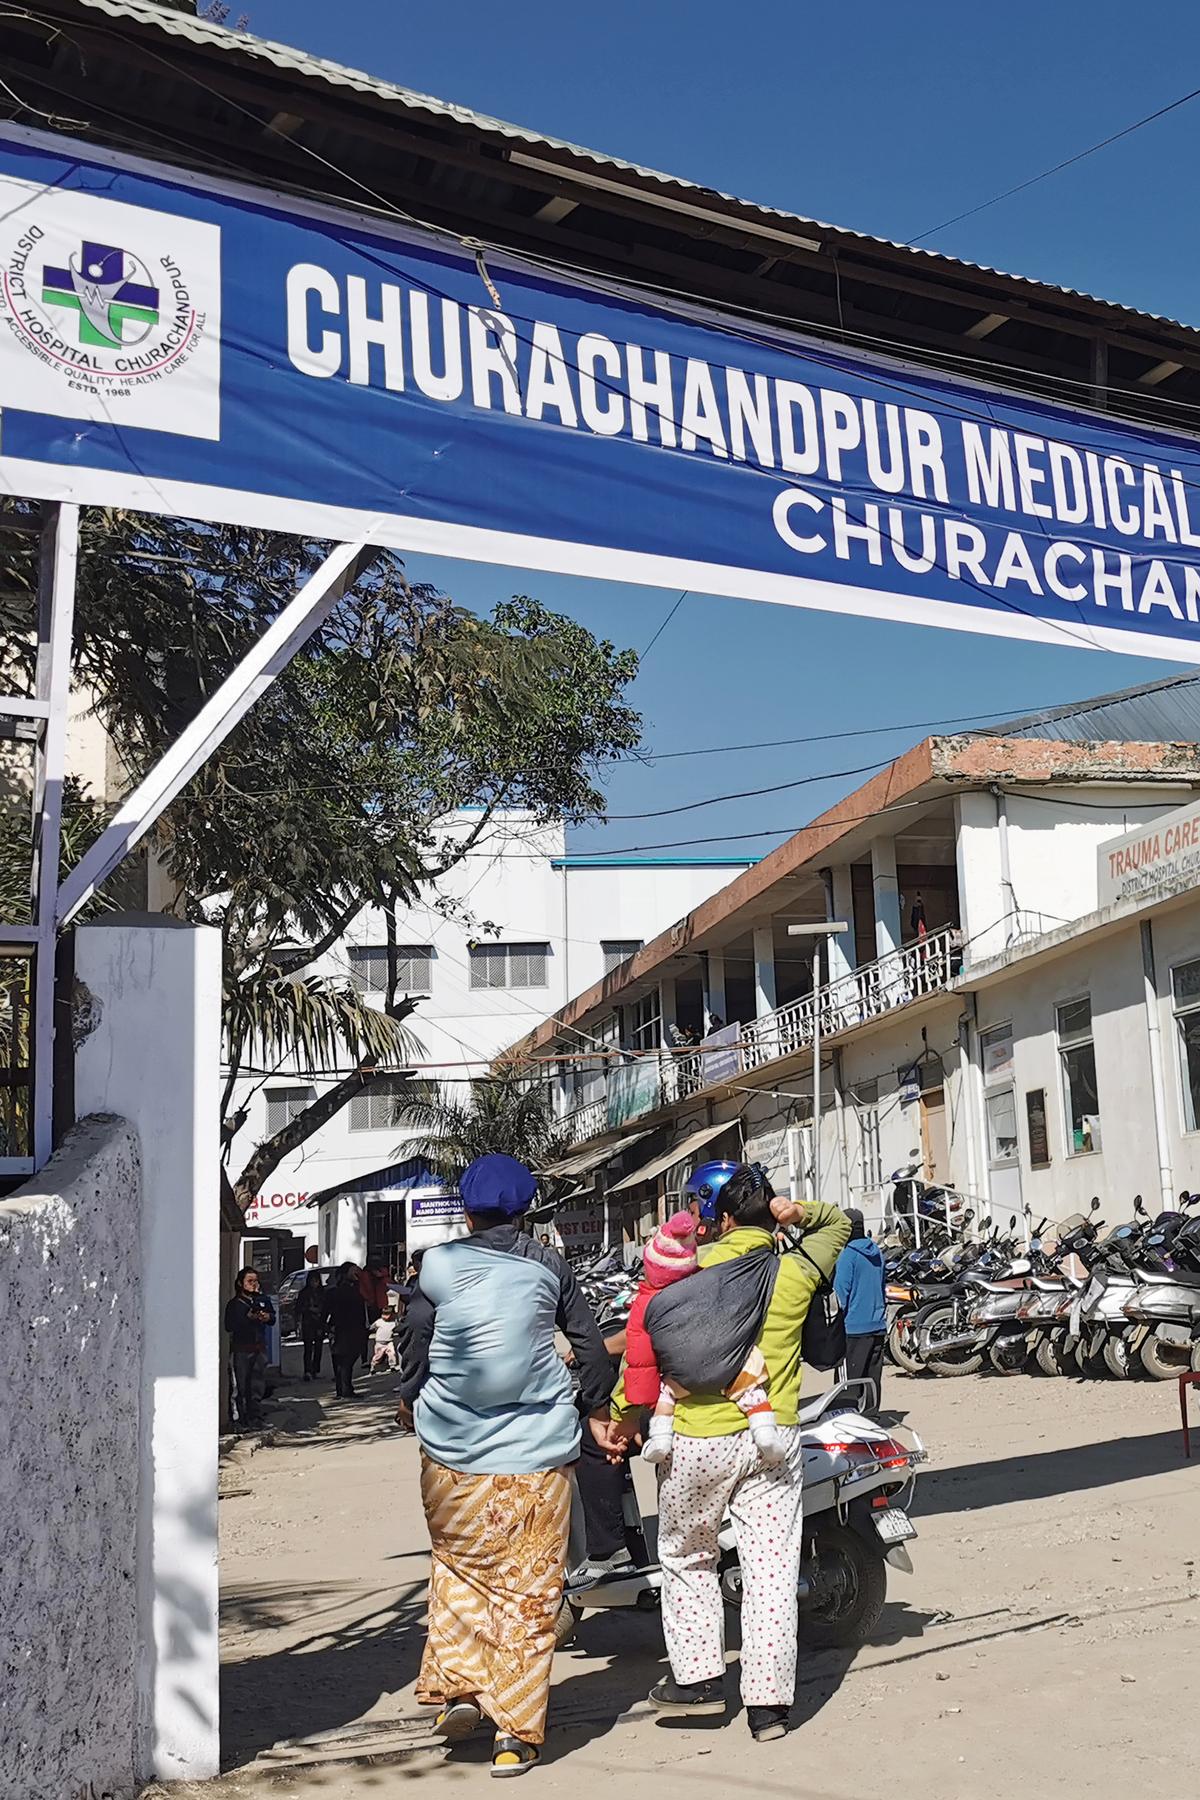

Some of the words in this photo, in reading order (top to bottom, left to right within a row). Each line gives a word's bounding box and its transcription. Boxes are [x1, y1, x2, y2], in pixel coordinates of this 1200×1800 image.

[9, 225, 45, 299] DISTRICT
[20, 309, 103, 370] HOSPITAL
[115, 254, 190, 372] CHURACHANDPUR
[4, 316, 61, 371] ACCESSIBLE
[64, 367, 114, 387] QUALITY
[120, 371, 163, 387] HEALTH
[164, 353, 189, 375] CARE
[187, 334, 201, 353] FOR
[196, 312, 207, 332] ALL
[286, 263, 951, 504] CHURACHANDPUR
[106, 388, 131, 397] 1968
[1108, 834, 1161, 879] TRAUMA
[1164, 815, 1200, 856] CARE
[1121, 872, 1151, 895] DISTRICT
[1150, 859, 1180, 882] HOSPITAL
